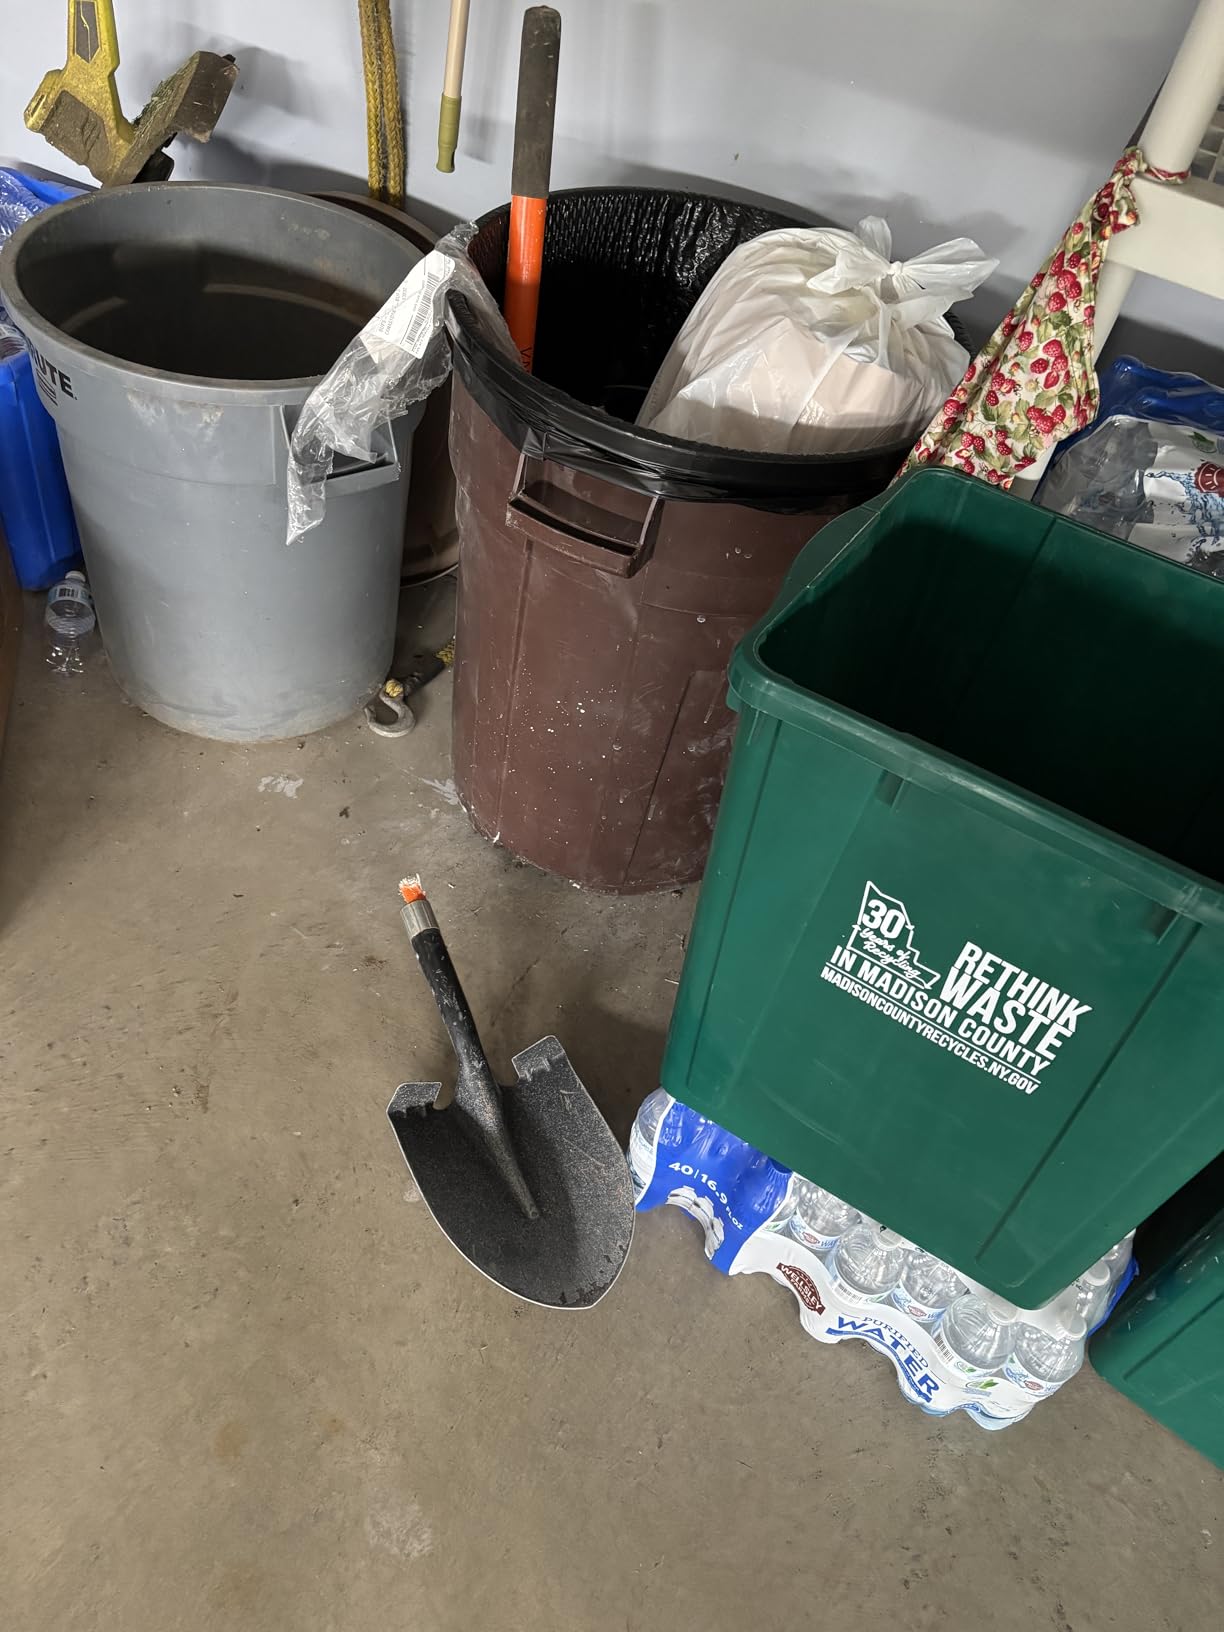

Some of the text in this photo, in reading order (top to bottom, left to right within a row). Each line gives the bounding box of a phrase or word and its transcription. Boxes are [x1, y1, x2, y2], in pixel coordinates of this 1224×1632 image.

[860, 928, 911, 962] Years of
[862, 899, 906, 939] 30
[863, 941, 922, 980] Recycling
[953, 941, 1092, 1033] RETHINK
[820, 965, 1040, 1094] MADISONCOUNTYRECYCLES.NY.GOV
[830, 945, 1050, 1076] IN MADISON COUNTY
[939, 966, 1073, 1061] WASTE
[781, 1265, 822, 1309] WELLSLEY
[838, 1315, 940, 1396] WATER
[863, 1316, 929, 1368] PURIFIED
